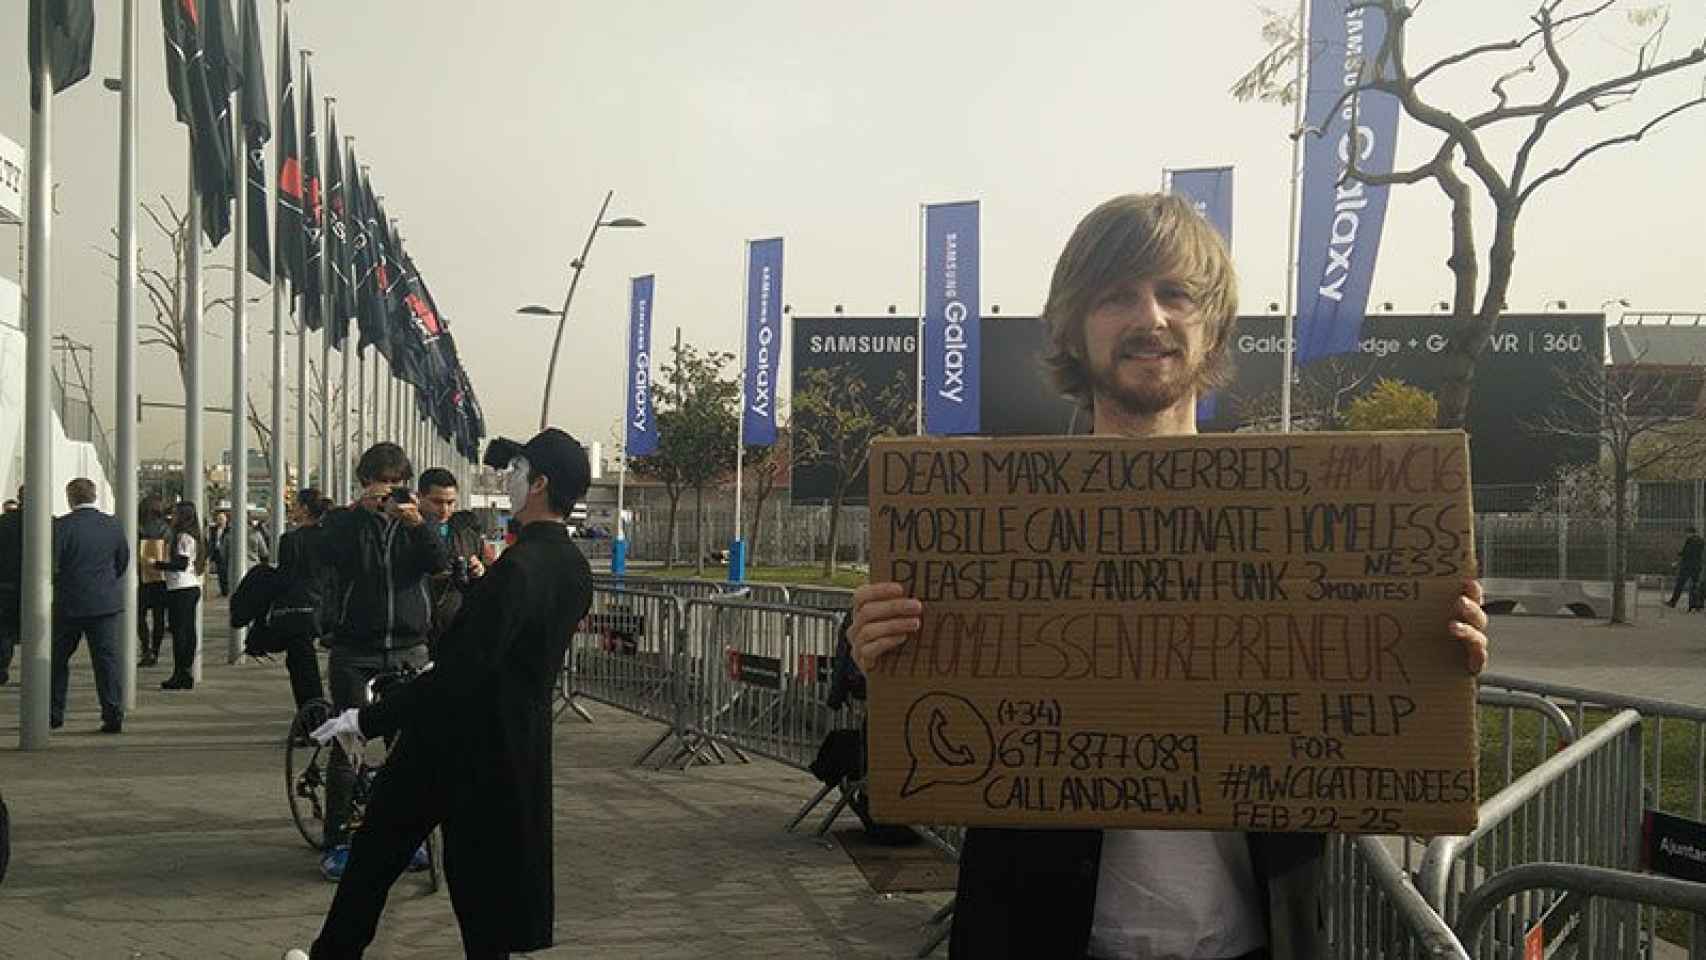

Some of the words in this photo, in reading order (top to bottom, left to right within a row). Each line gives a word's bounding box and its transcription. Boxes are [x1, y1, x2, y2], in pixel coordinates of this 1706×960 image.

[1319, 126, 1375, 301] Galaxy
[810, 335, 916, 353] SAMSUNG
[939, 302, 967, 402] Galaxy
[1490, 334, 1519, 353] VR
[1544, 334, 1582, 353] 360
[883, 450, 970, 495] DEAR
[982, 449, 1072, 495] MARK
[1317, 443, 1467, 493] #MWC16
[1024, 506, 1087, 554] CAN
[1097, 505, 1276, 555] ELIMINATE
[891, 559, 1000, 601] PLEASE
[1007, 559, 1084, 601] GIVE
[1092, 558, 1201, 602] ANDREW
[1212, 560, 1289, 601] FUNK
[998, 699, 1062, 726] (+34)
[1223, 693, 1302, 735] FREE
[1321, 692, 1417, 737] HELP
[1000, 729, 1199, 772] 697877089
[1290, 738, 1344, 760] FOR
[1233, 803, 1289, 830] FEB
[1302, 806, 1402, 831] 22-25
